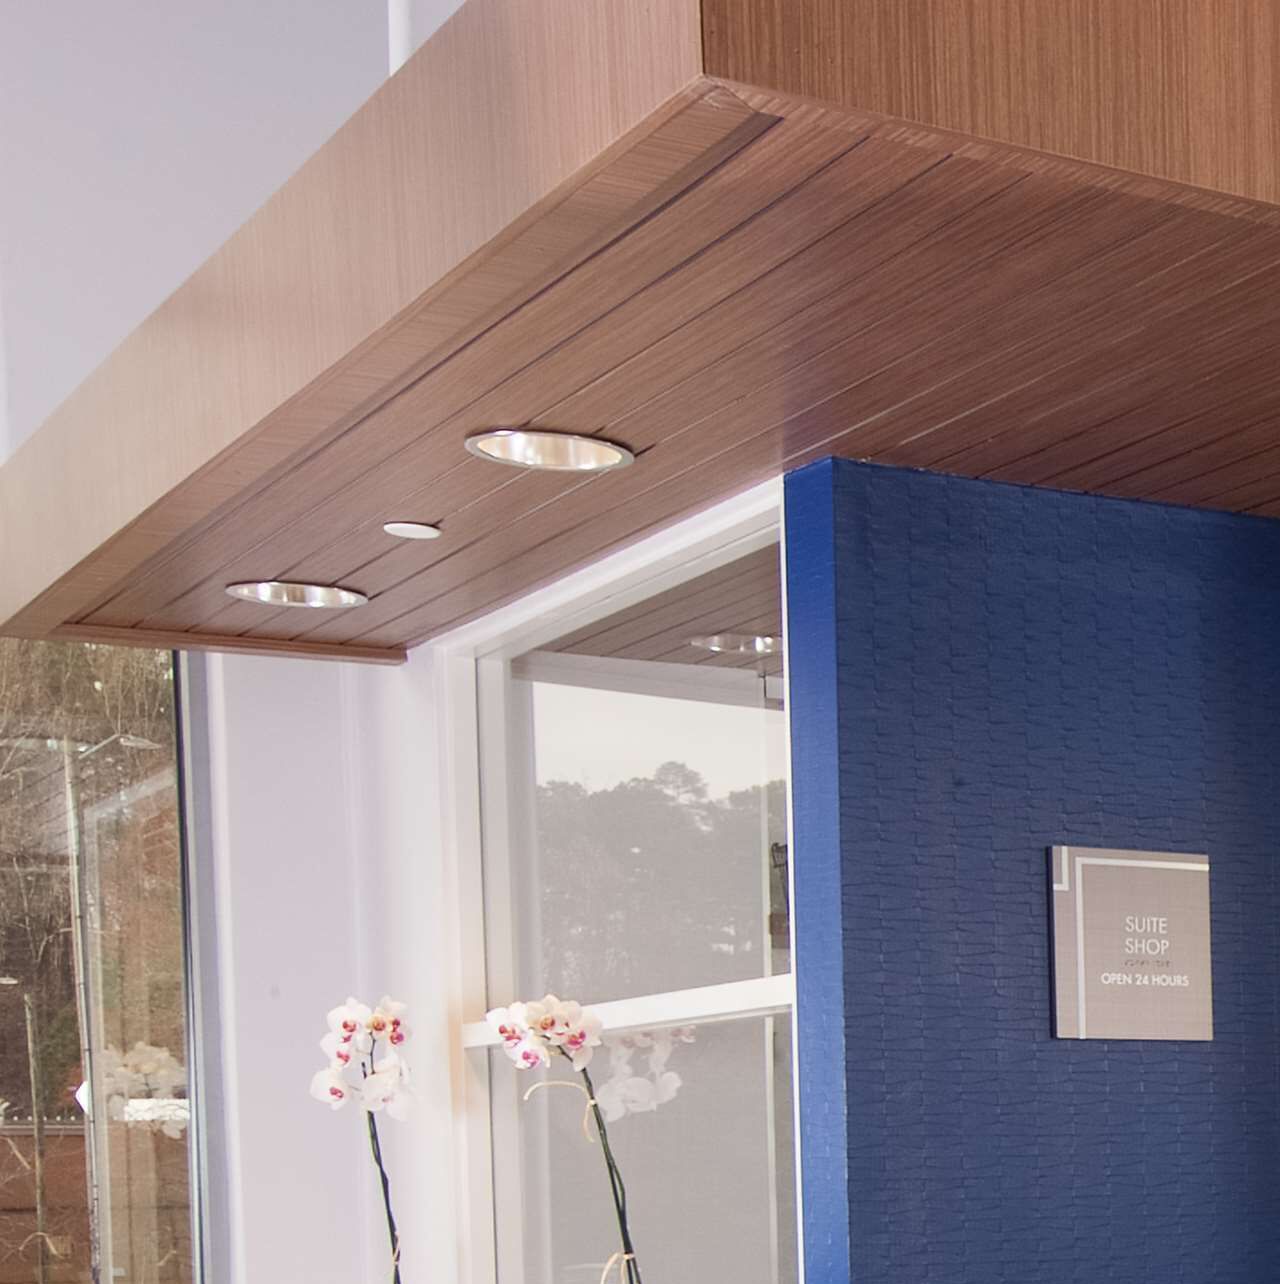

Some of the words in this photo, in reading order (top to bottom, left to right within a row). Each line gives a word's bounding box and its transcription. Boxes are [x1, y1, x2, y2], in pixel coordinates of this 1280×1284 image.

[1124, 915, 1168, 934] SUITE
[1124, 938, 1170, 956] SHOP
[1100, 972, 1132, 985] OPEN
[1135, 973, 1150, 986] 24
[1152, 974, 1190, 987] HOURS
